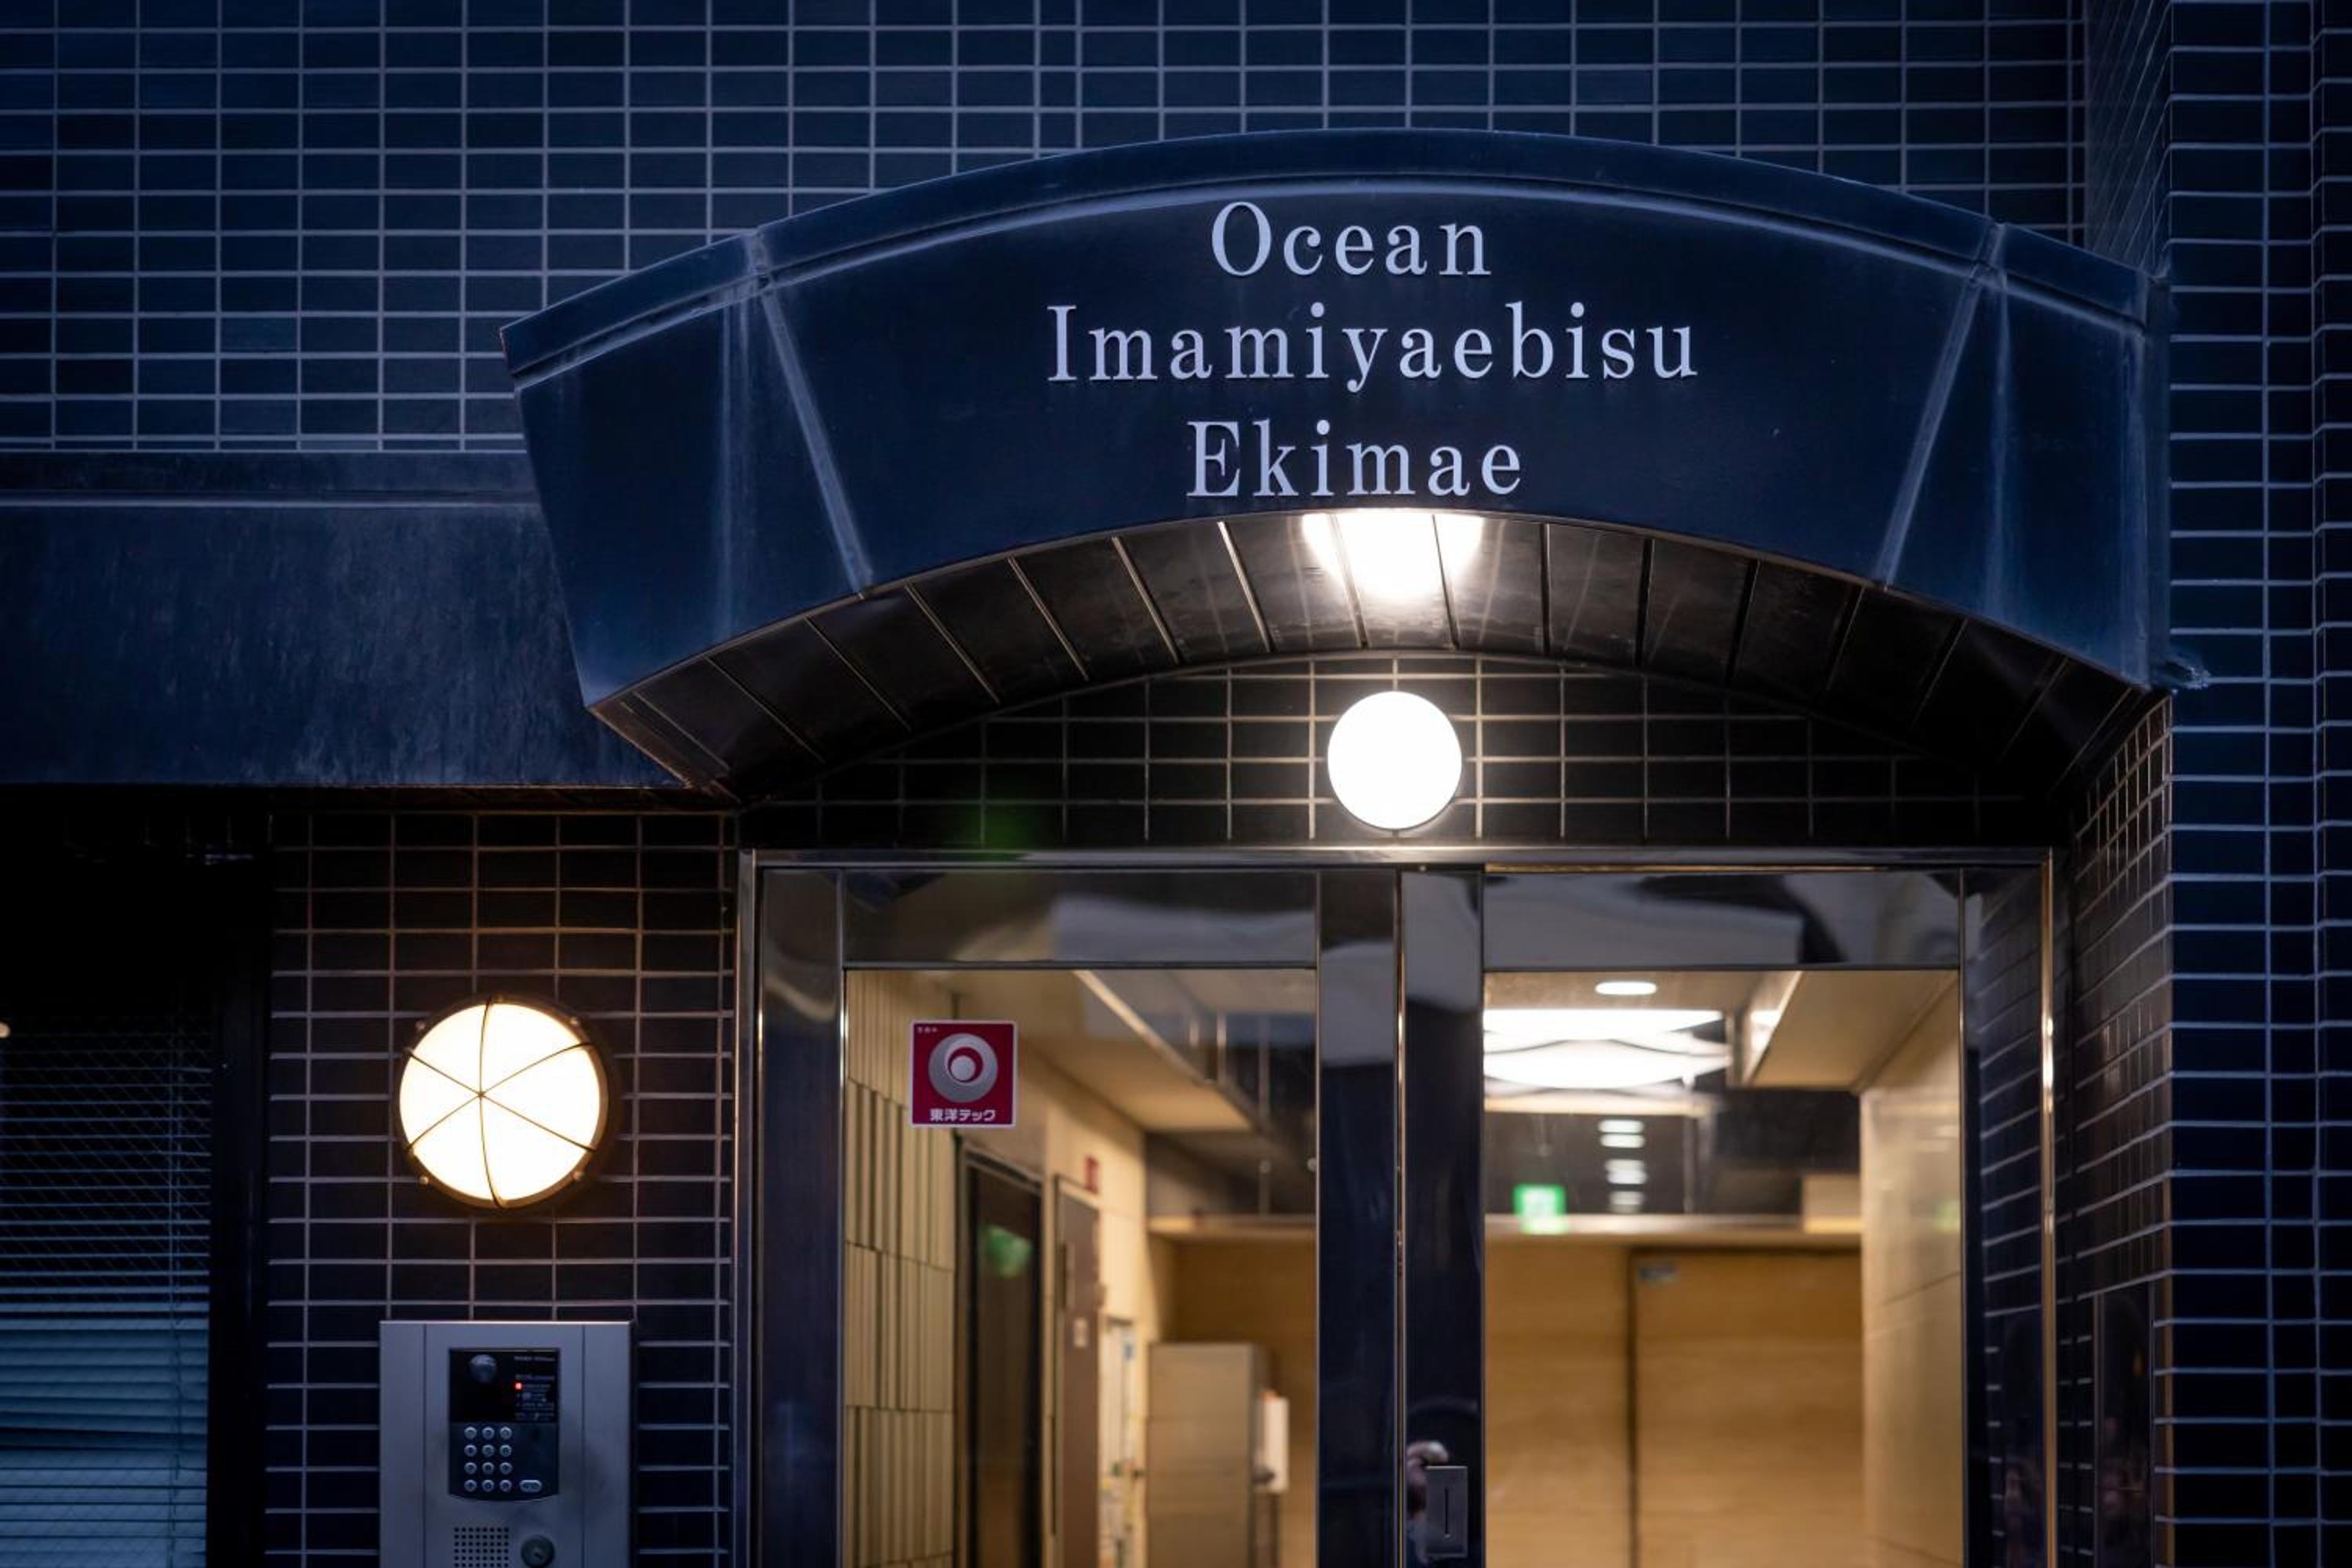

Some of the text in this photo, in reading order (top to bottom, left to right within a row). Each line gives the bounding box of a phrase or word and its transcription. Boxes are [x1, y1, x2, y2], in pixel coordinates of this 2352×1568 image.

[1211, 201, 1491, 276] Ocean
[1047, 301, 1697, 393] Imamiyaebisu
[1186, 419, 1521, 496] Ekimae
[929, 1108, 996, 1122] 東洋テック
